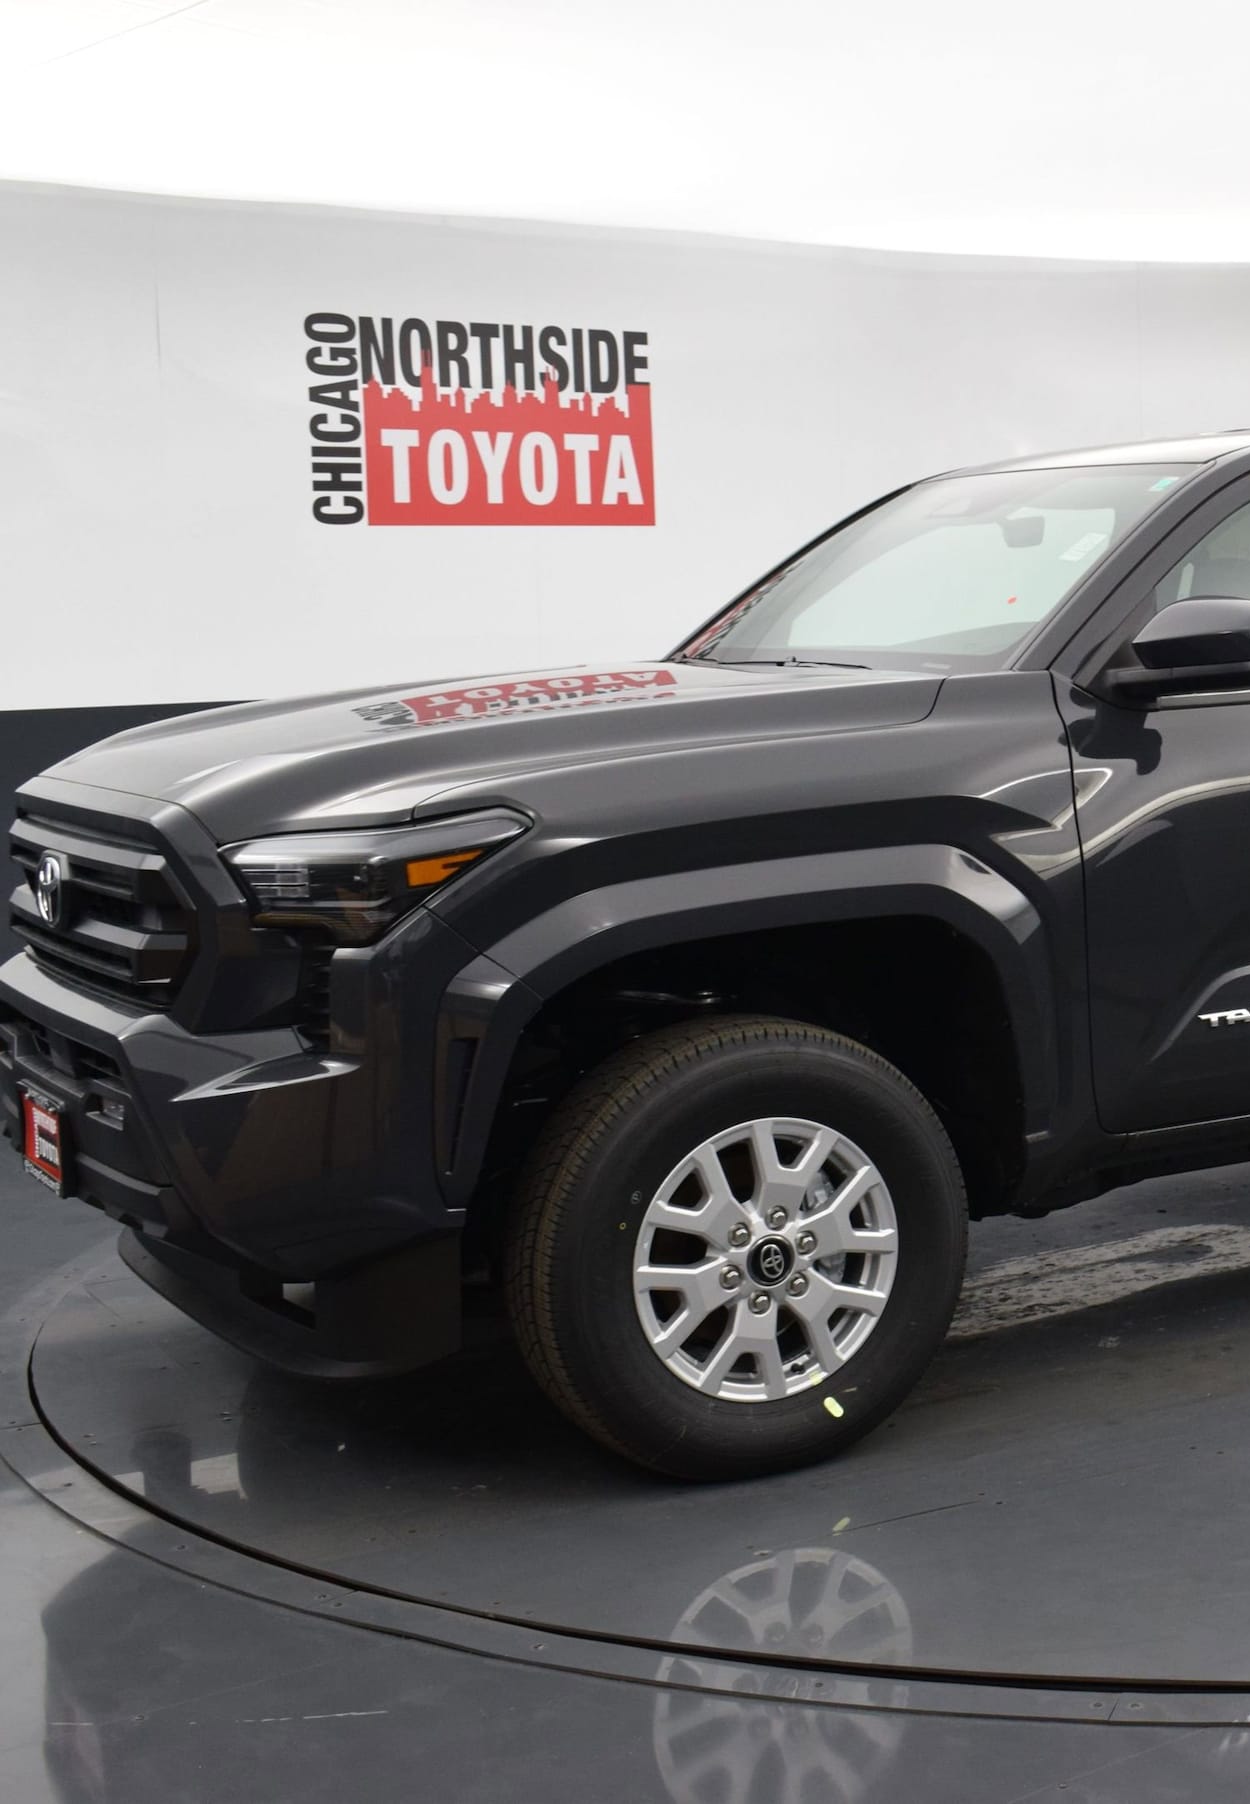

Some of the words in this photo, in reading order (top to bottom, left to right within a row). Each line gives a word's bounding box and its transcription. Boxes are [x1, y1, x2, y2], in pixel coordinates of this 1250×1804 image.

[358, 315, 651, 394] NORTHSIDE
[303, 312, 364, 525] CHICAGO
[380, 428, 645, 506] TOYOTA
